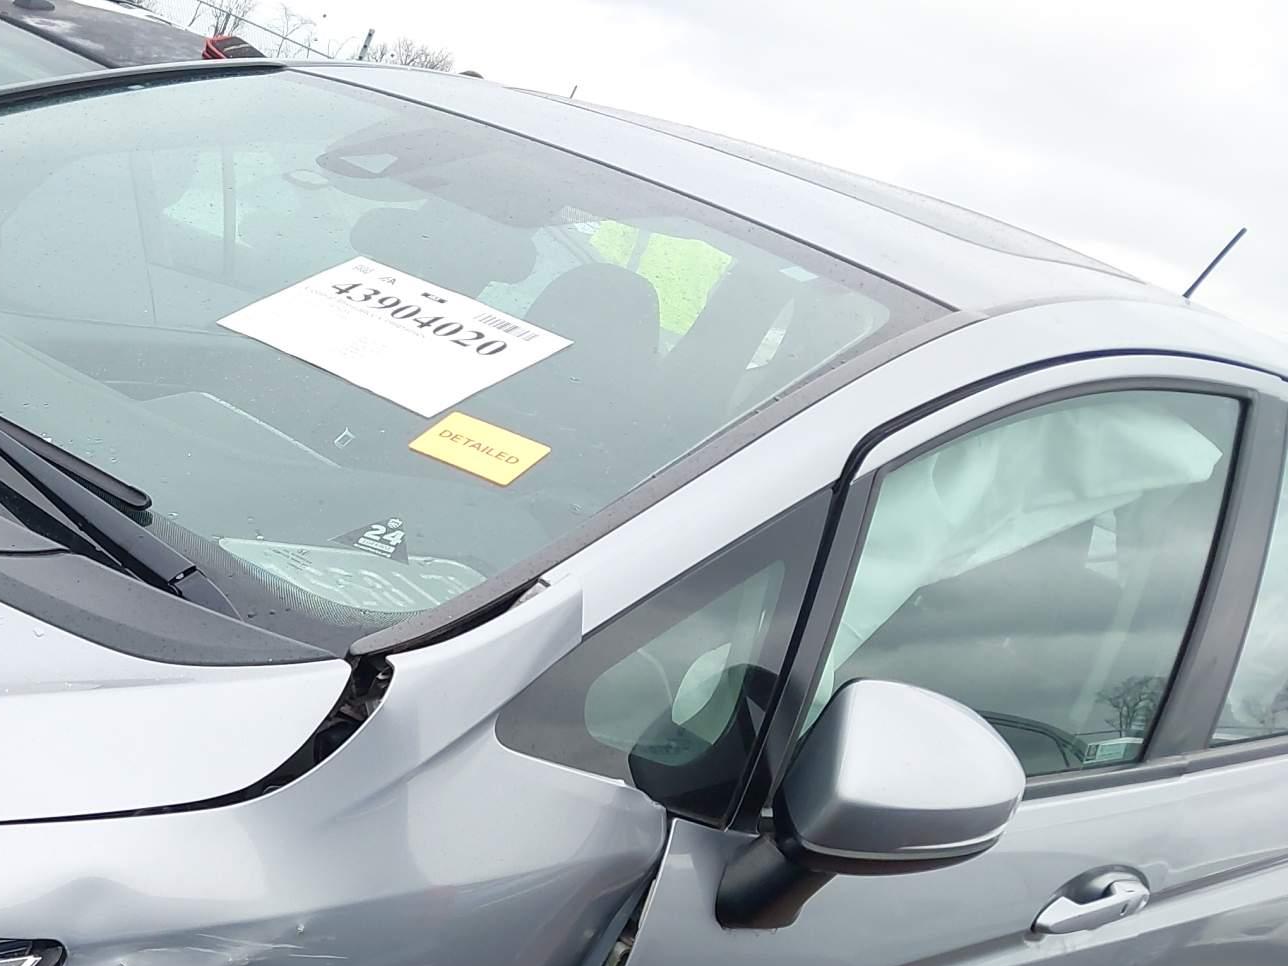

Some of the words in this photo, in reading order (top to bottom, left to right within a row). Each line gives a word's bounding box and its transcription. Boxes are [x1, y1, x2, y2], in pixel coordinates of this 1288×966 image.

[331, 282, 508, 356] 43904020
[438, 429, 520, 465] DETAILED
[363, 524, 405, 546] 24
